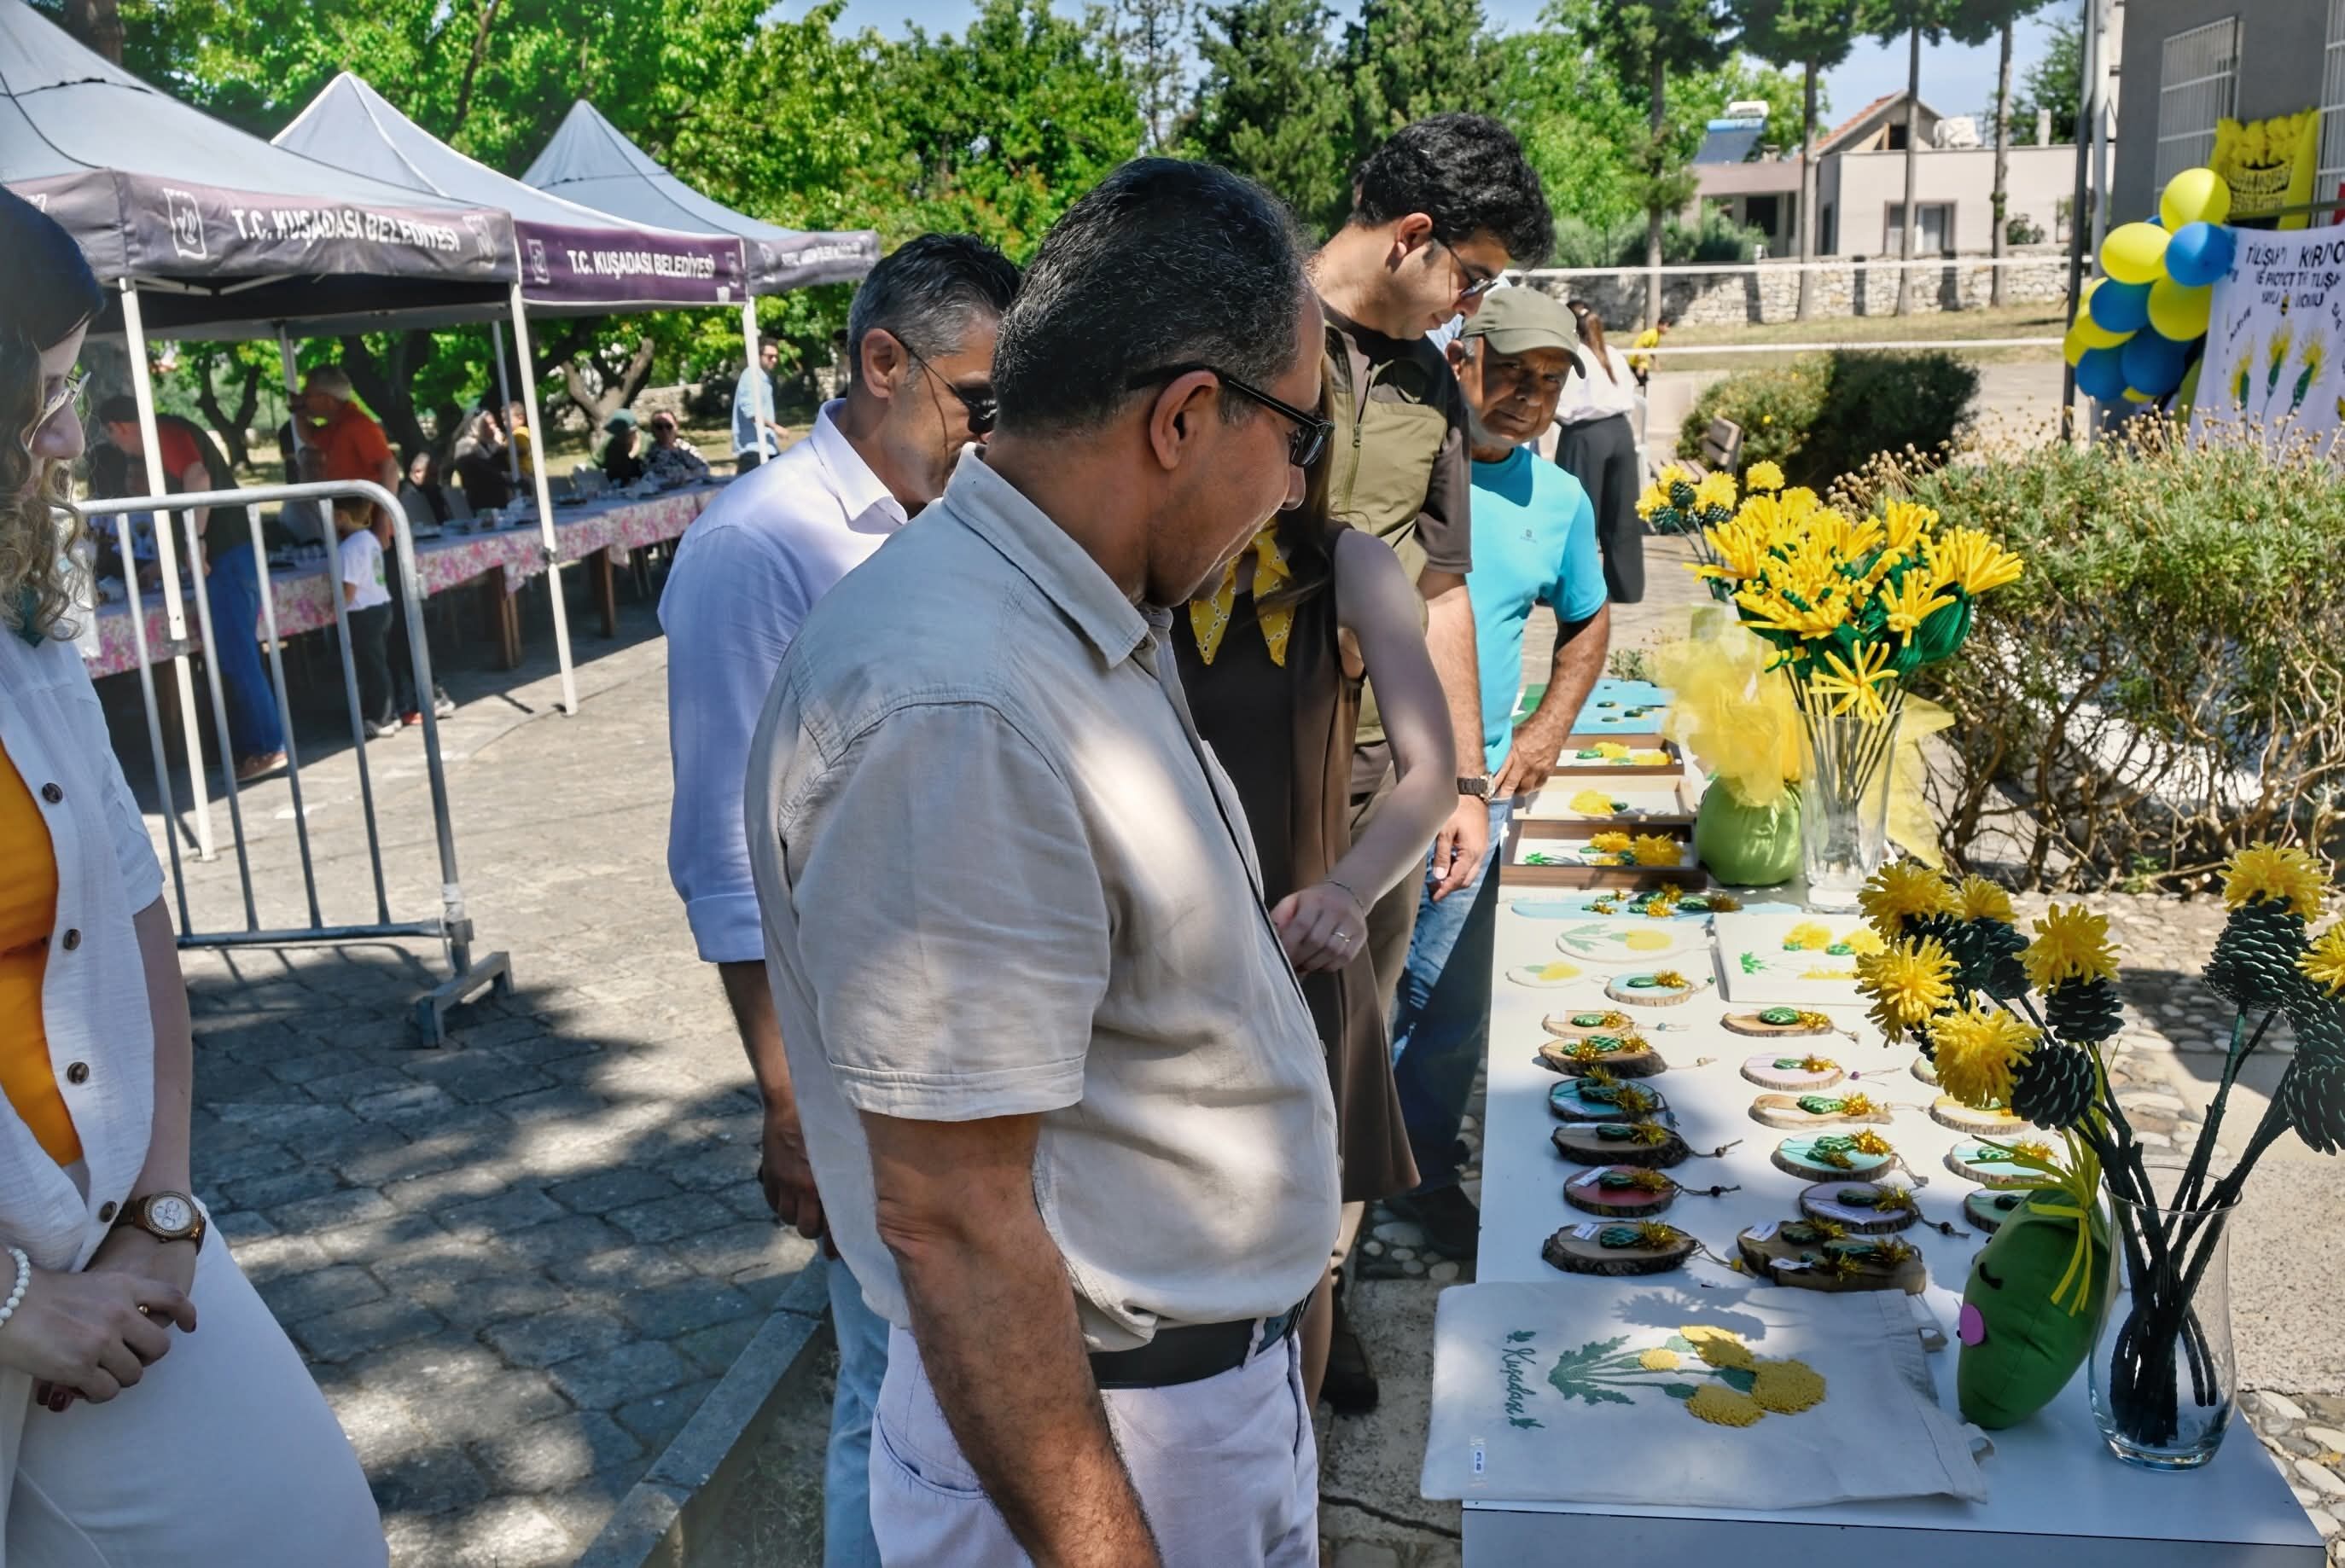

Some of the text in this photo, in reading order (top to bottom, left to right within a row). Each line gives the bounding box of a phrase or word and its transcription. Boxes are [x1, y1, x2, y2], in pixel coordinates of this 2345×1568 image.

[231, 209, 272, 240] T.C.
[272, 209, 365, 247] KUŞADASI
[567, 250, 716, 280] T.C. KUŞADASI BELEDİYESİ
